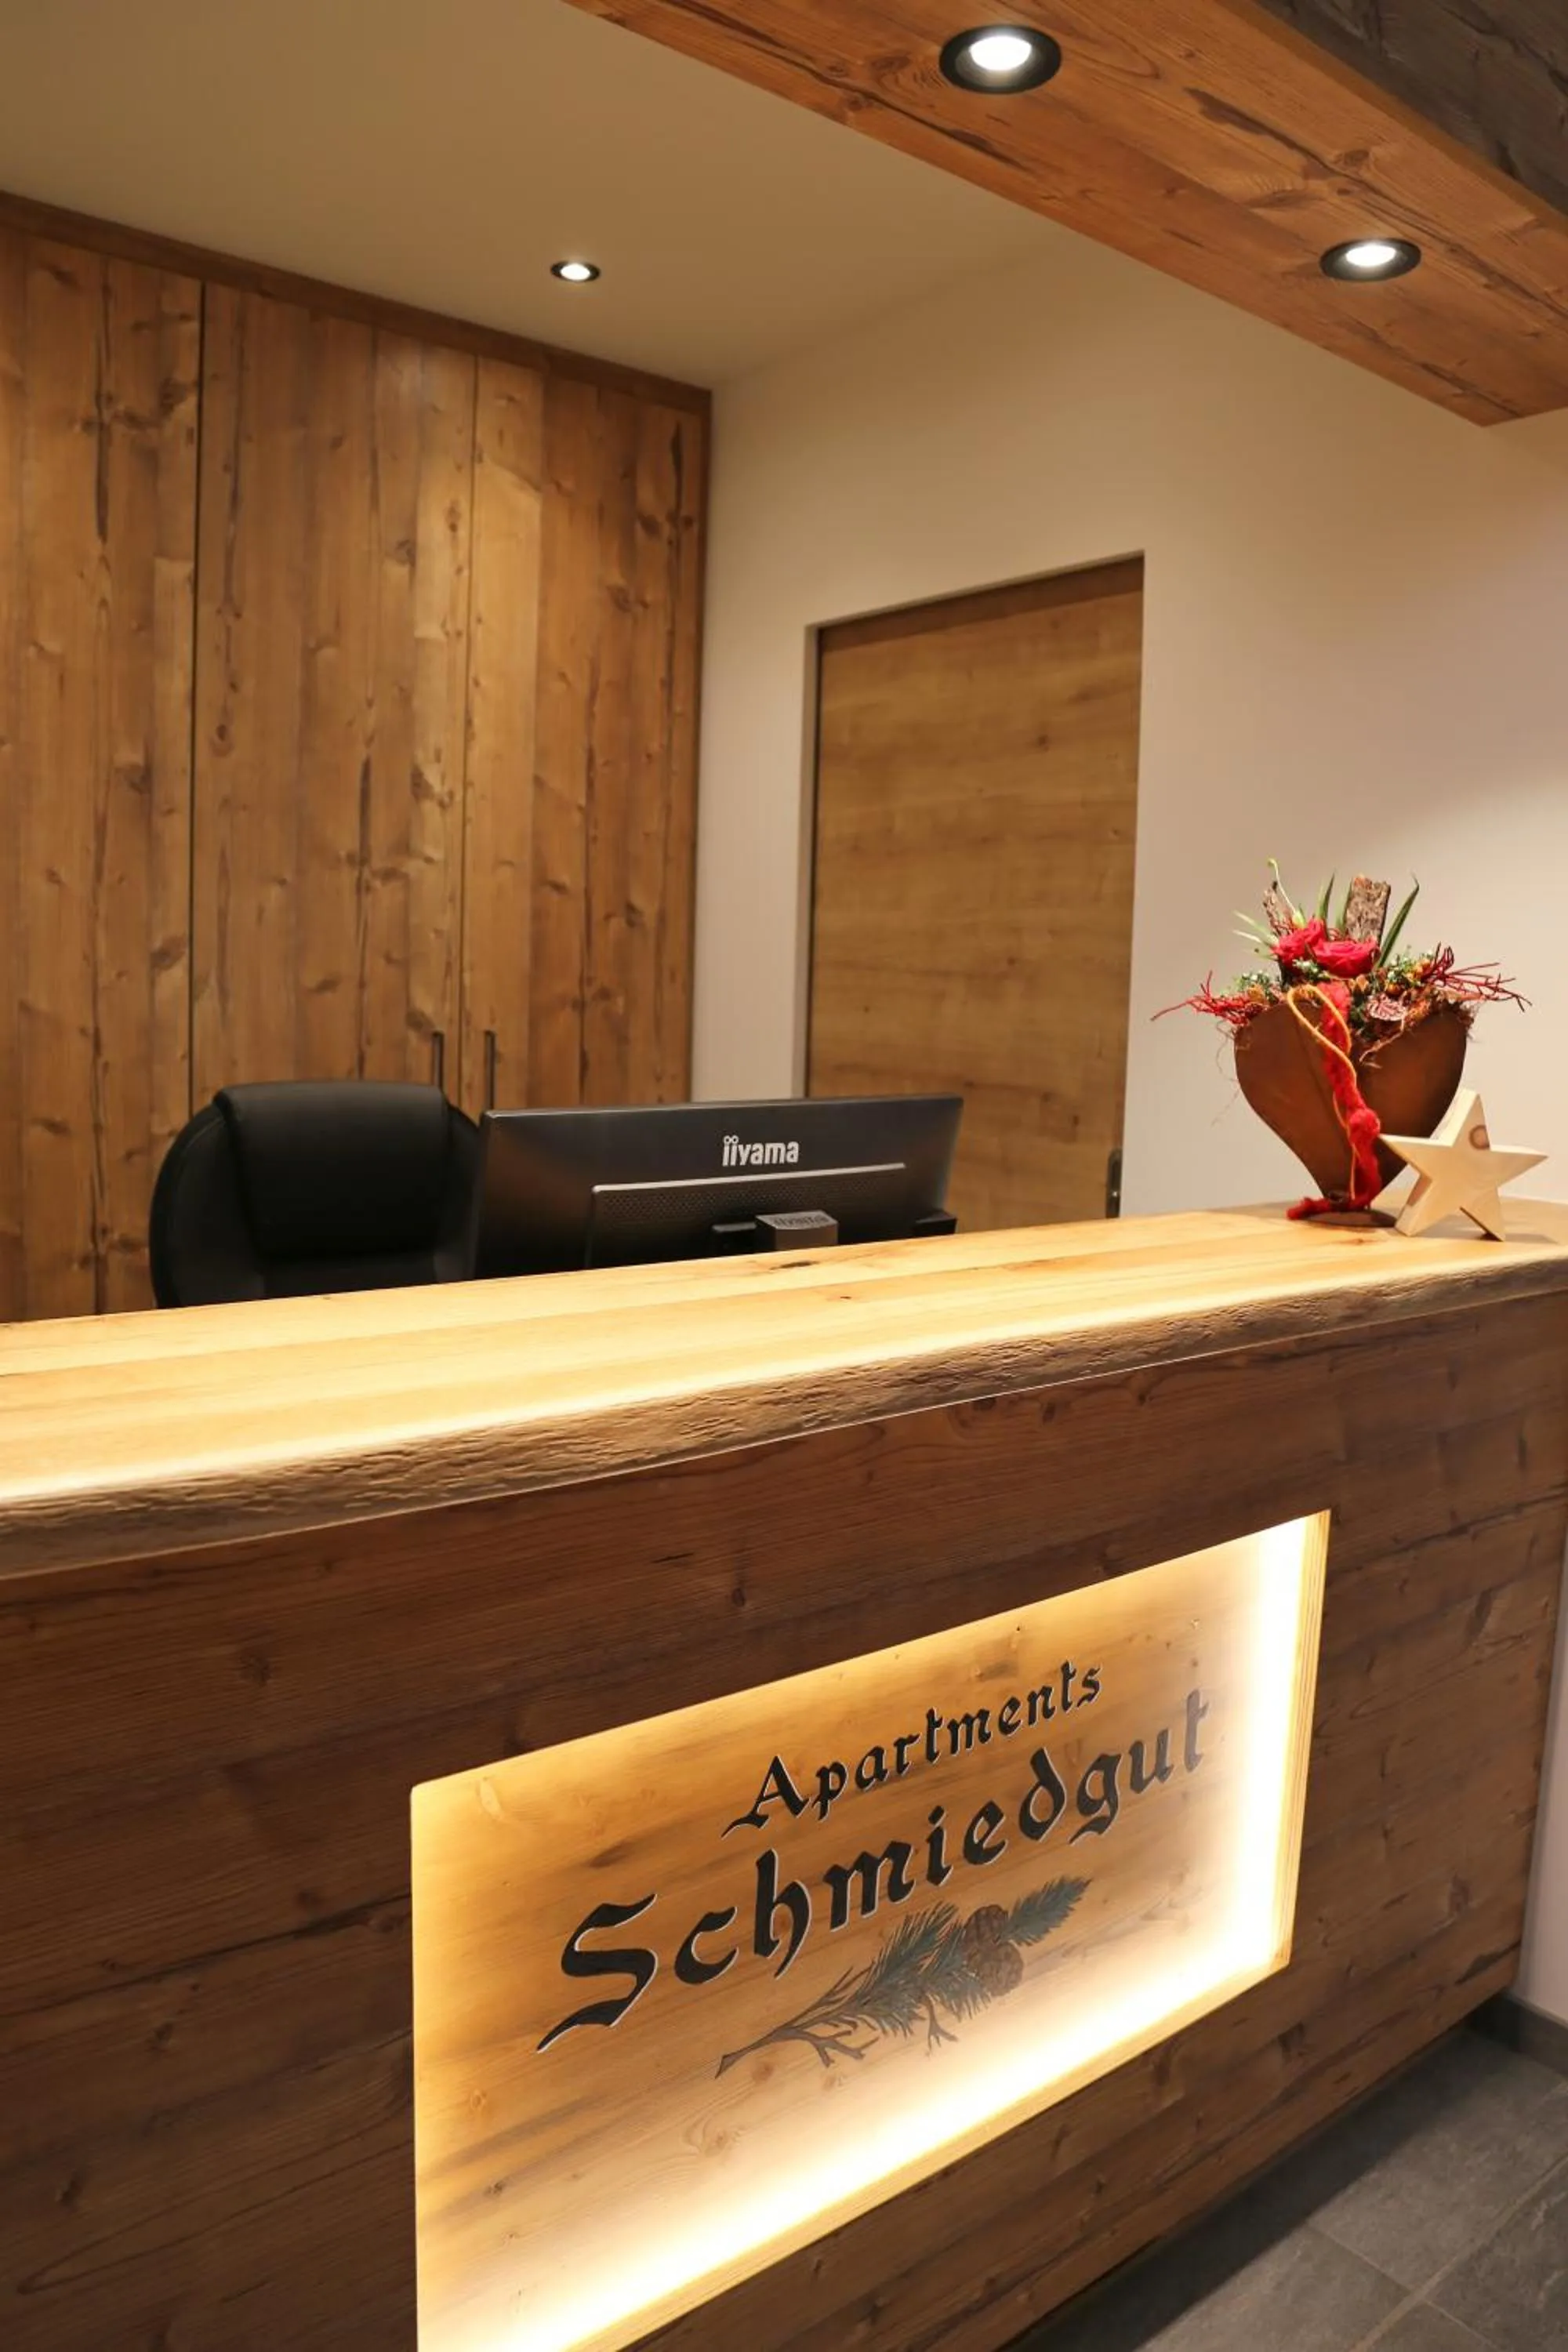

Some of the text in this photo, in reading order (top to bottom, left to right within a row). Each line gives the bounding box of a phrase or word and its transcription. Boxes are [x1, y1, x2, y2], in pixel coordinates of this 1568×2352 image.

[722, 1135, 800, 1167] iiyama
[721, 1660, 1101, 1839] Apartments
[536, 1689, 1209, 2054] Schmiedgut
